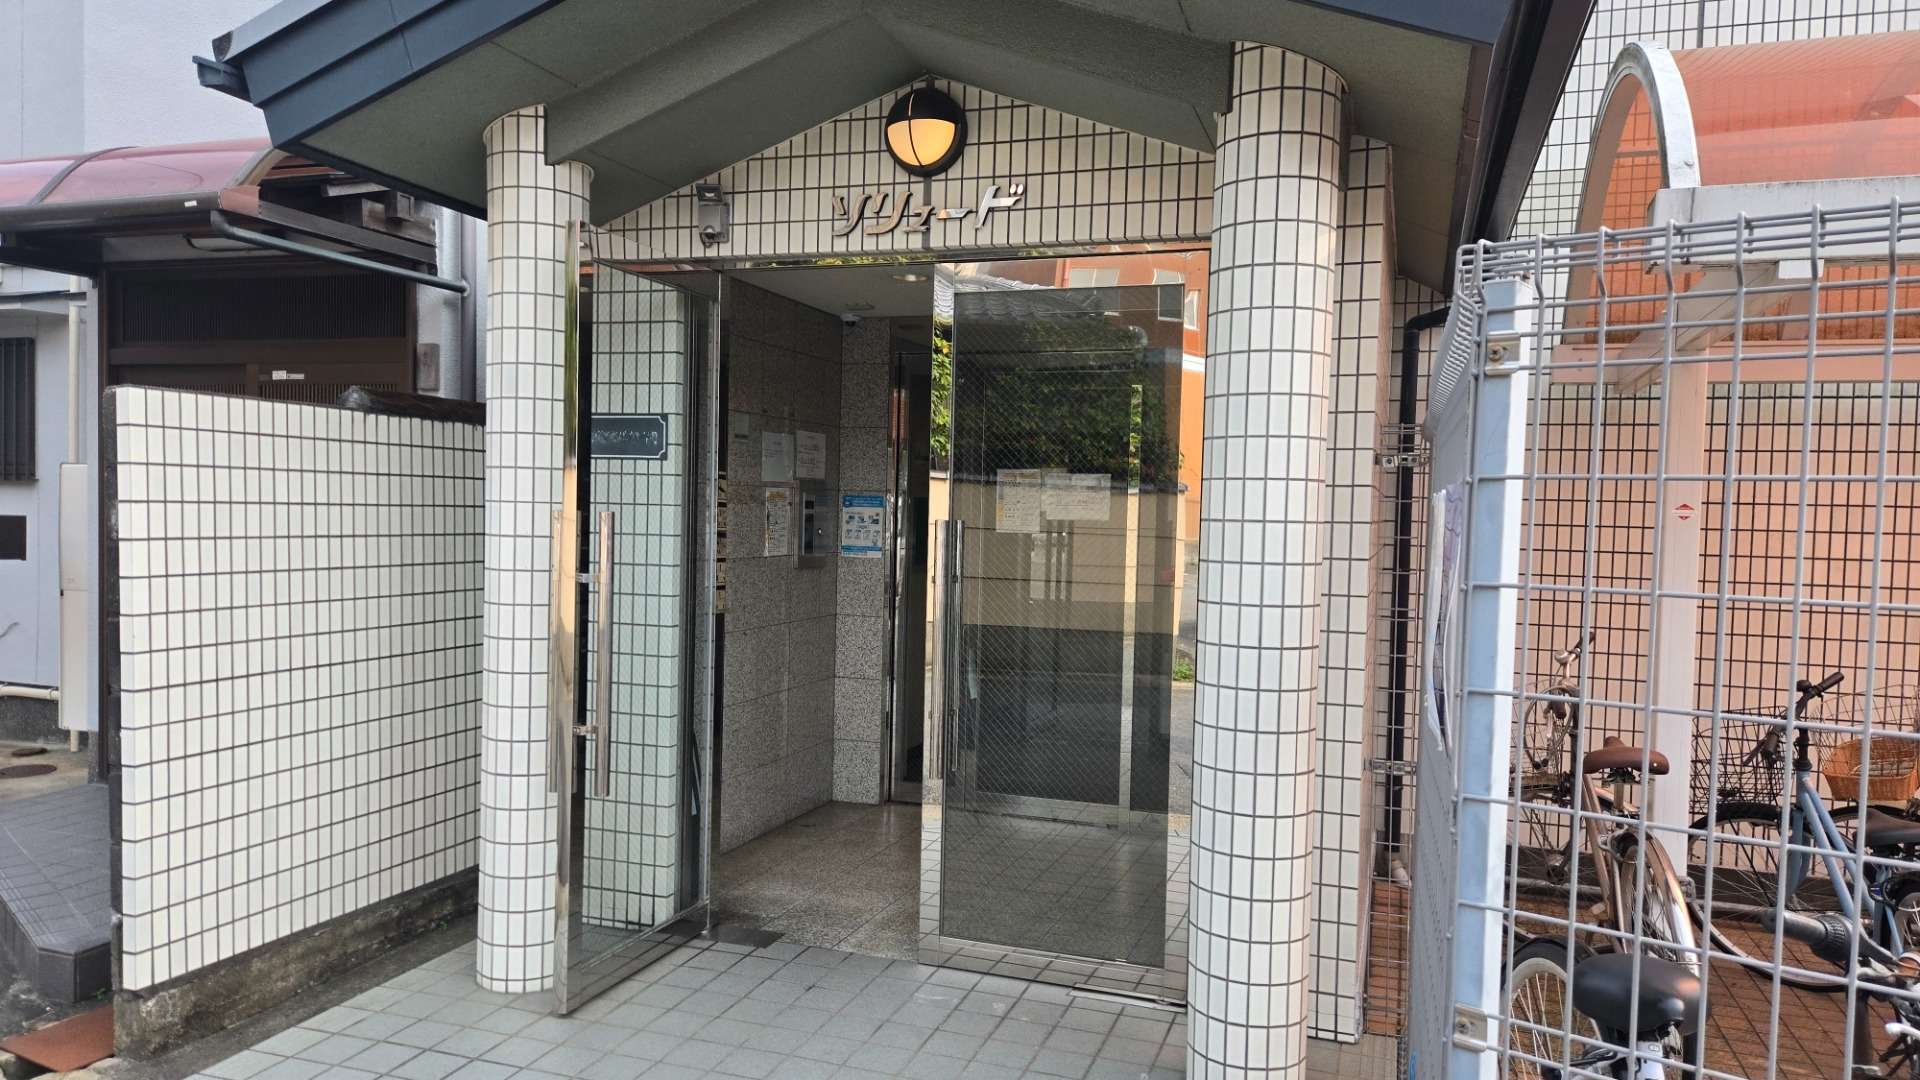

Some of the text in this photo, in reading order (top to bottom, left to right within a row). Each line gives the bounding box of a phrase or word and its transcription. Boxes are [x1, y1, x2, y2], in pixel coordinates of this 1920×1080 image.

[832, 183, 1024, 236] ソリュード
